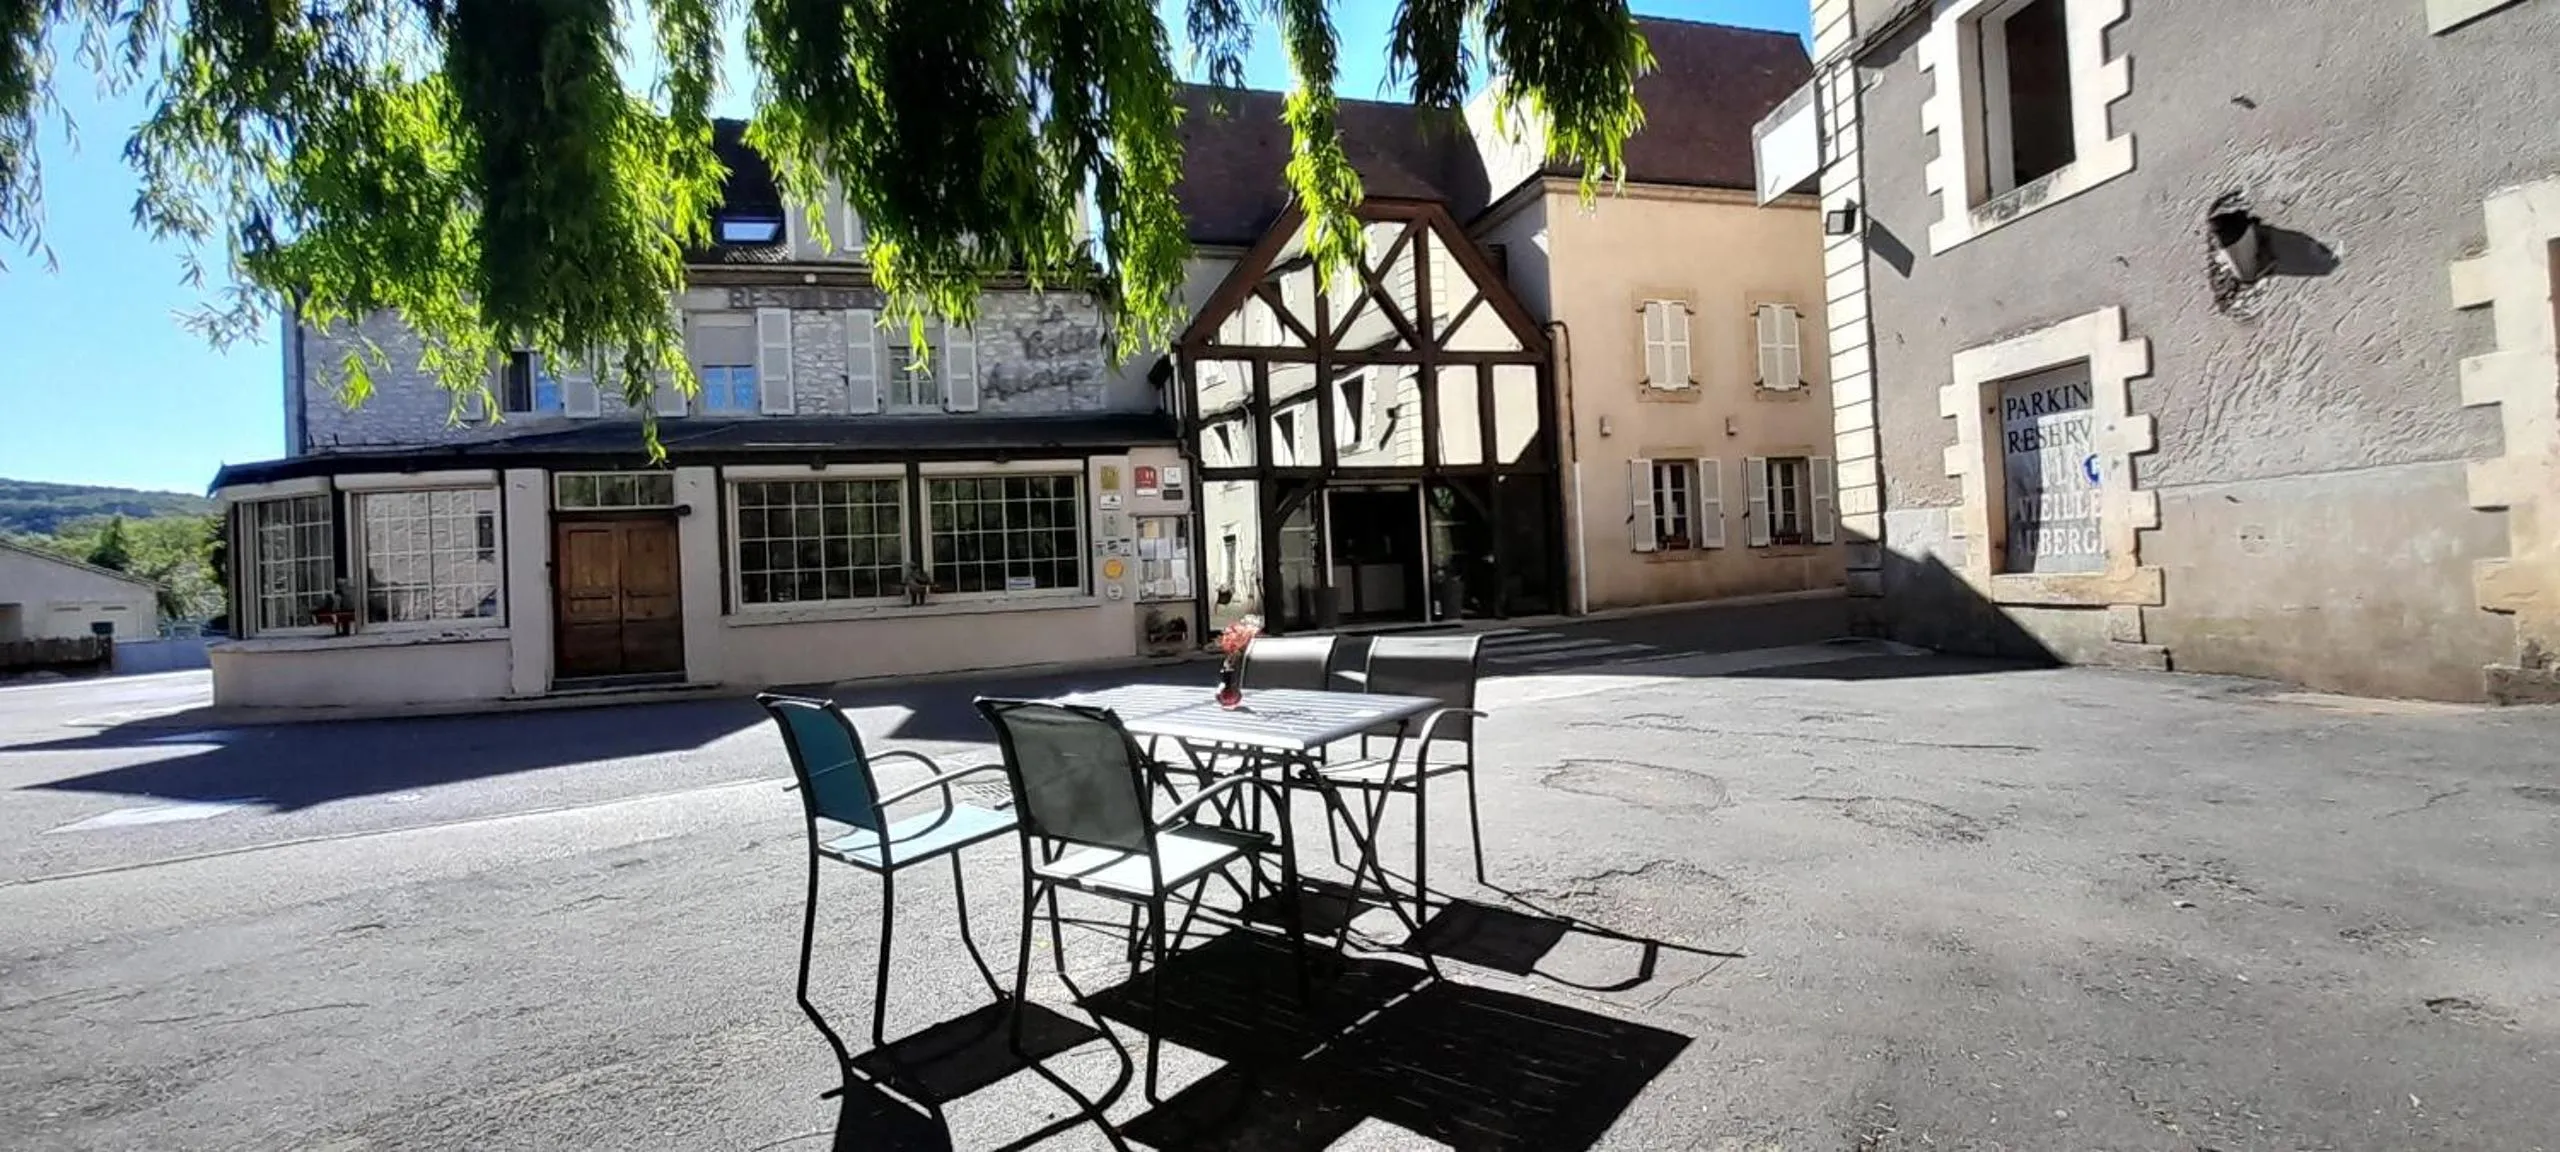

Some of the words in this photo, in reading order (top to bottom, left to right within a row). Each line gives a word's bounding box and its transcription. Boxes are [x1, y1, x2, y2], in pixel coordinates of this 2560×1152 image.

[2007, 382, 2093, 420] PARKIN
[2008, 418, 2093, 453] RESERV
[2016, 527, 2105, 556] AUBERG
